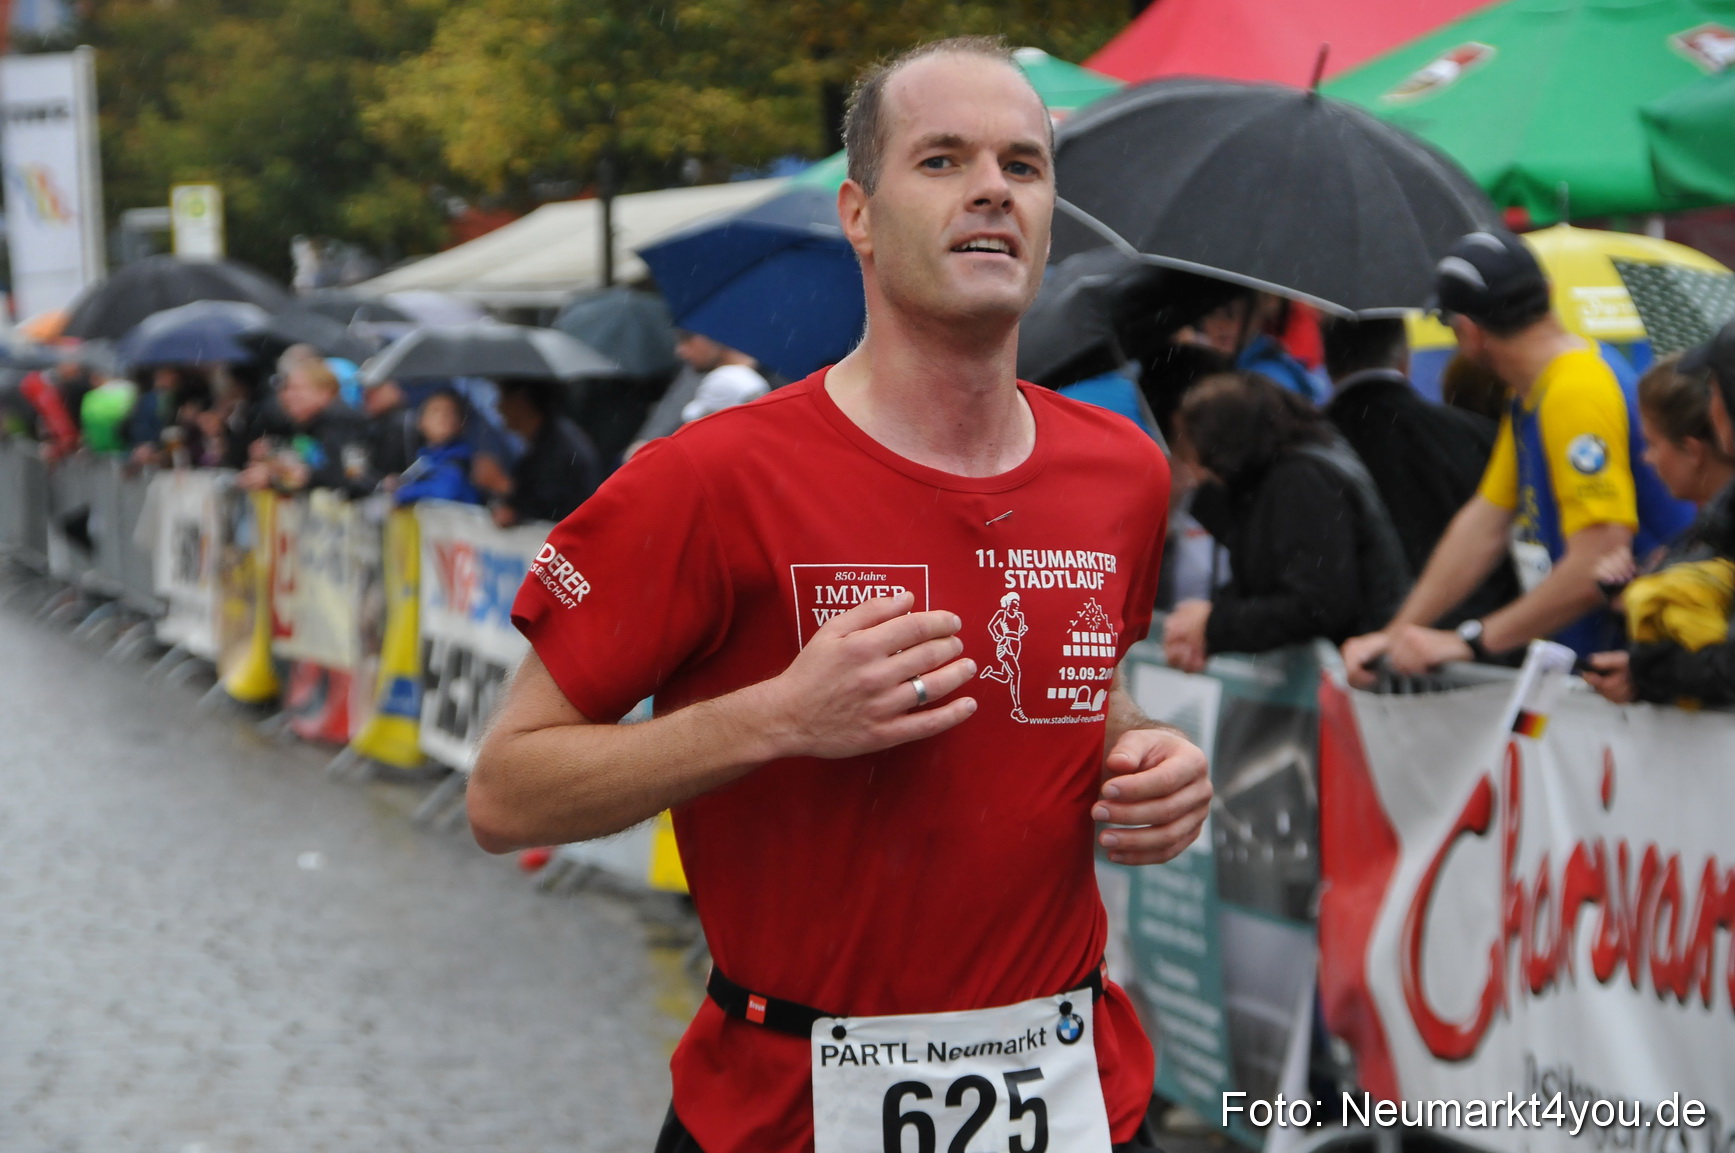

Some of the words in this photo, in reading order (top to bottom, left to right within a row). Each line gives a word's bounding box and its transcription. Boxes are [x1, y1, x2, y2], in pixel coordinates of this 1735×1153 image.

[534, 542, 591, 603] DERER
[834, 571, 857, 581] 850
[857, 571, 887, 581] Jahre
[975, 549, 1004, 568] 11.
[1008, 549, 1117, 574] NEUMARKTER
[1004, 570, 1105, 591] STADTLAUF
[529, 562, 577, 610] SELLSCHAFT
[820, 1042, 918, 1066] PARTL
[927, 1027, 1047, 1062] Neumarkt
[882, 1066, 1049, 1153] 625
